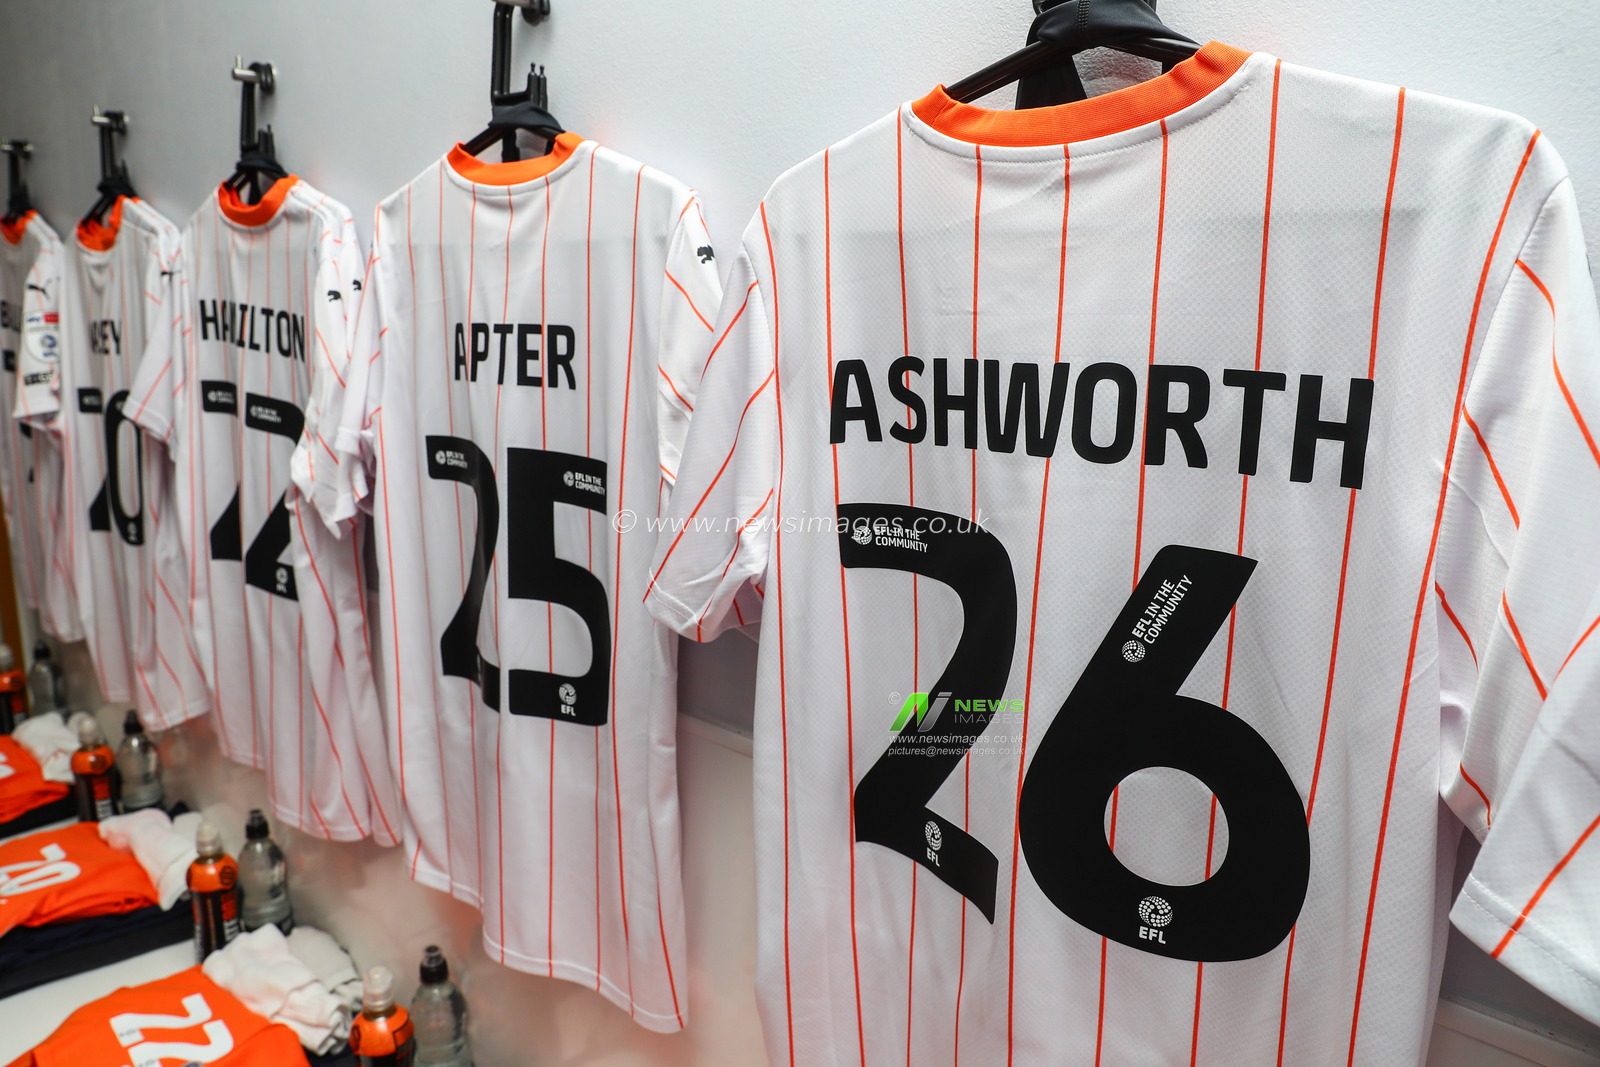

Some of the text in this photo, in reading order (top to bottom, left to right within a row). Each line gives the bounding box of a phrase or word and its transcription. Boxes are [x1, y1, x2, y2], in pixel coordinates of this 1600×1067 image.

[454, 322, 577, 390] APTER
[829, 354, 1376, 490] ASHWORTH
[575, 471, 585, 481] EFL
[592, 476, 602, 487] THE
[575, 480, 605, 496] COMMUNITY
[874, 526, 920, 541] EFL IN THE
[875, 536, 928, 553] COMMUNITY
[425, 435, 612, 727] 25
[1131, 579, 1175, 638] EFL IN THE
[1143, 574, 1193, 644] COMMUNITY
[561, 703, 576, 717] EFL
[835, 503, 1311, 963] 26
[926, 847, 940, 867] EFL
[1138, 925, 1167, 945] EFL
